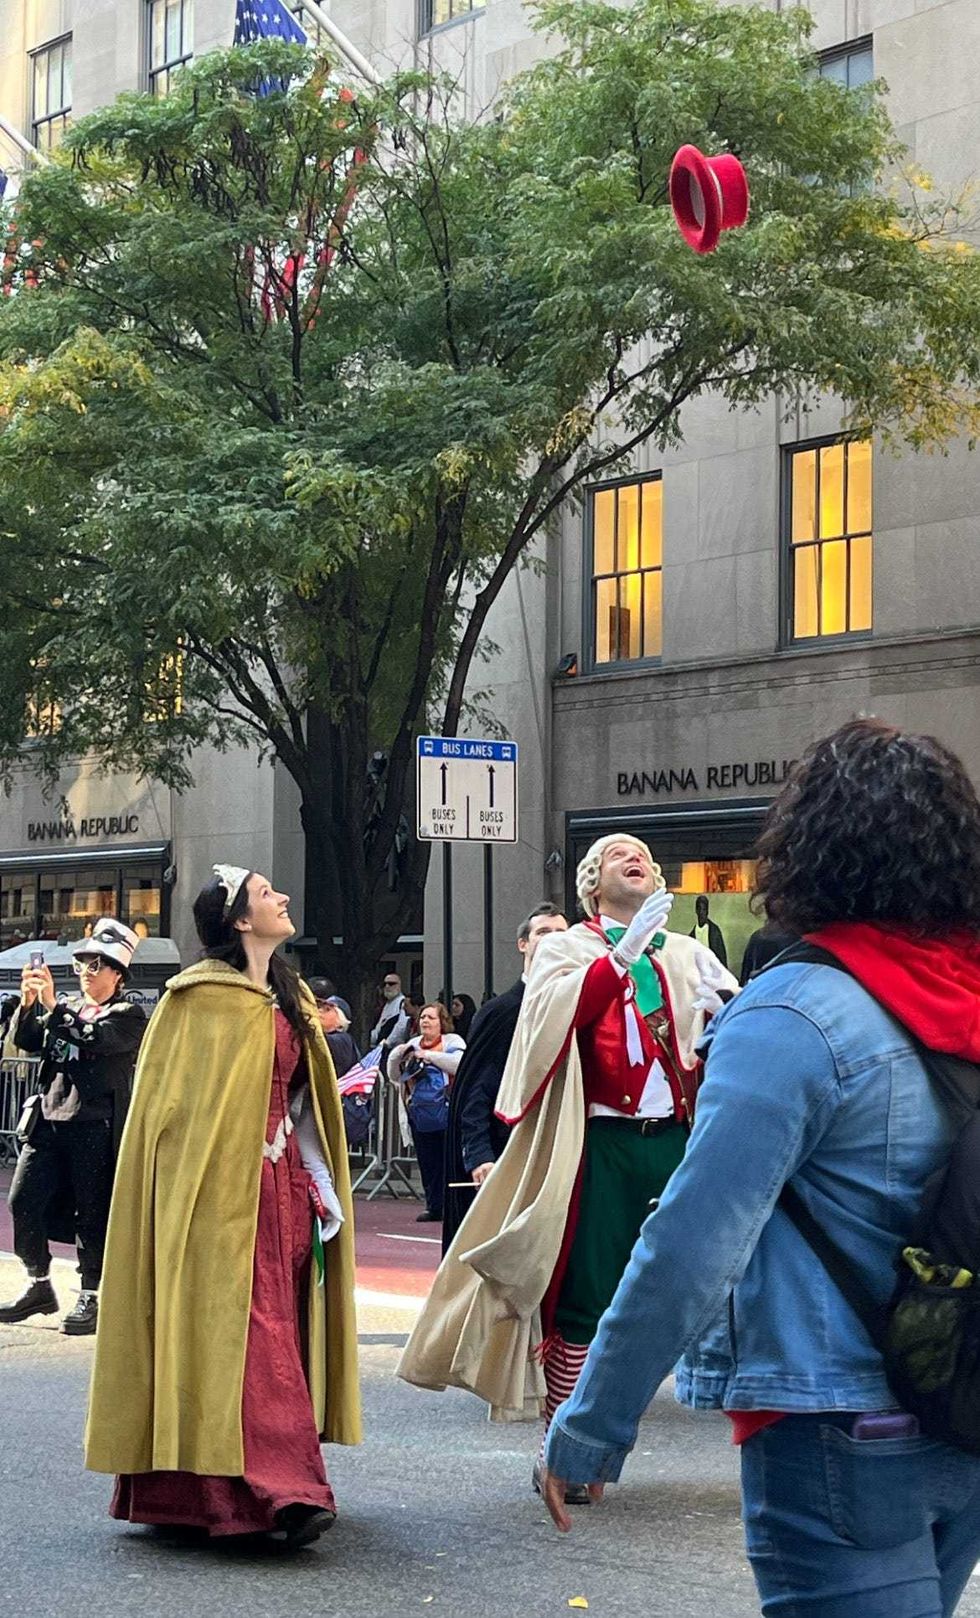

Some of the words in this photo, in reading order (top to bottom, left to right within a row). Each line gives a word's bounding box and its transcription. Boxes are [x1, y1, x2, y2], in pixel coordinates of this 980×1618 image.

[442, 742, 461, 755] BUS
[463, 744, 494, 757] LANES
[617, 768, 698, 796] BANANA
[431, 808, 457, 821] BUSES
[479, 810, 504, 823] BUSES
[27, 820, 77, 841] BANANA
[80, 815, 139, 838] REPUBLIC
[433, 823, 455, 835] ONLY
[481, 825, 502, 837] ONLY
